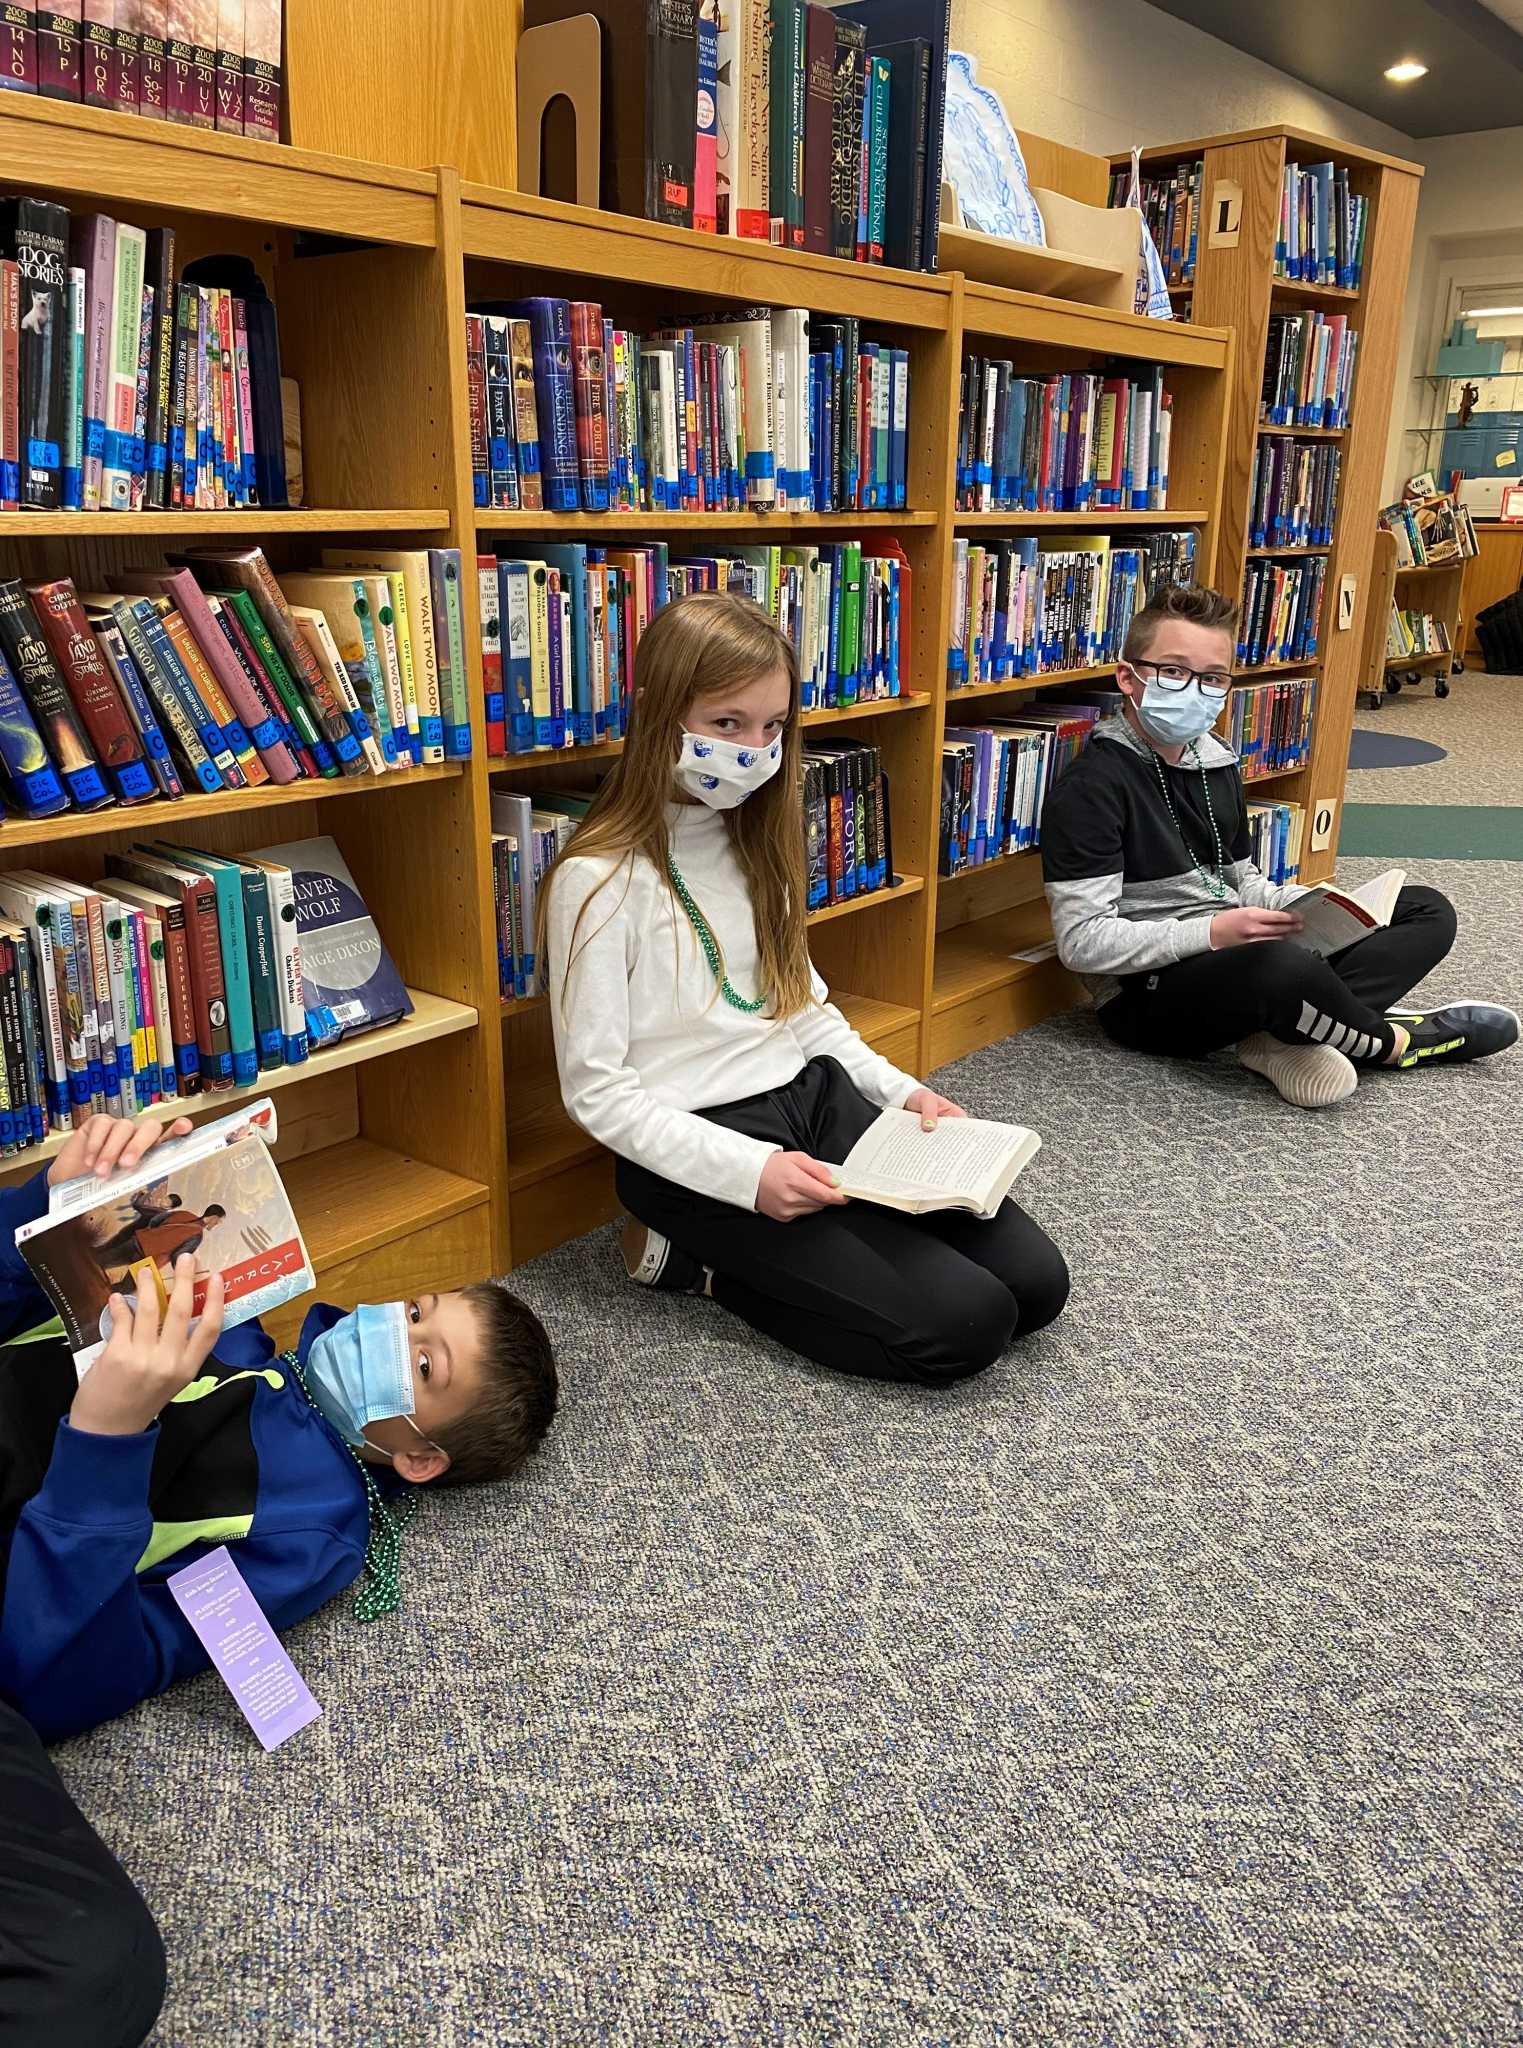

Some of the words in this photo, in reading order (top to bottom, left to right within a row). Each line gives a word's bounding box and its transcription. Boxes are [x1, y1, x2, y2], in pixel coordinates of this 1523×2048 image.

[5, 5, 27, 19] 2005
[53, 16, 74, 30] 2005
[10, 28, 24, 44] 14
[91, 24, 110, 38] 2005
[118, 32, 137, 46] 2005
[144, 36, 163, 50] 2005
[751, 1, 762, 62] Fishing
[790, 8, 800, 68] Illustrated
[12, 47, 24, 63] N
[57, 37, 71, 53] 15
[94, 45, 108, 61] 16
[172, 41, 191, 55] 2005
[195, 48, 215, 61] 2005
[12, 62, 25, 77] O
[60, 57, 69, 71] P
[121, 53, 134, 67] 17
[148, 57, 161, 73] 18
[176, 61, 189, 78] 19
[222, 52, 241, 65] 2005
[255, 61, 274, 74] 2005
[94, 65, 107, 81] Q
[121, 72, 133, 85] S-
[144, 75, 163, 92] So-
[197, 68, 212, 84] 20
[224, 72, 237, 87] 21
[96, 79, 105, 94] R
[120, 85, 134, 101] Sn
[147, 89, 161, 105] Sz
[177, 80, 186, 95] T
[199, 86, 209, 101] U
[218, 87, 233, 103] W
[236, 93, 243, 107] X
[257, 81, 270, 96] 22
[199, 99, 209, 113] V
[221, 100, 230, 115] Y
[232, 105, 241, 119] Z
[249, 95, 278, 112] Research
[791, 69, 800, 131] Children's
[750, 73, 761, 178] Encyclopedia
[761, 100, 771, 135] New
[831, 76, 842, 209] DICTIONARY
[790, 134, 799, 195] Dictionary
[872, 169, 881, 243] DICTIONAR
[1216, 199, 1239, 233] L
[18, 245, 61, 270] DOG
[16, 258, 64, 286] STORIES
[10, 302, 18, 332] STORY
[178, 351, 187, 373] BEAST
[159, 380, 167, 408] DOWN
[177, 380, 186, 424] BASKERVILLE
[469, 384, 480, 414] FIRE
[495, 390, 504, 423] DARK
[592, 384, 602, 409] FIRE
[555, 381, 568, 455] ASCENDING
[470, 417, 481, 453] STAR
[593, 414, 603, 456] WORLD
[48, 592, 72, 604] CHRIS
[48, 599, 77, 613] COLFER
[398, 582, 406, 614] CREECH
[1341, 591, 1354, 617] N
[420, 595, 431, 635] WALK
[17, 640, 47, 671] LAND
[68, 638, 96, 667] LAND
[128, 626, 157, 674] GREGOR
[423, 638, 434, 669] TWO
[23, 663, 56, 684] STORIES
[73, 661, 105, 681] STORIES
[260, 635, 274, 654] SPY
[269, 651, 285, 676] NEXT
[281, 675, 297, 699] DOOR
[390, 658, 399, 686] TWO
[163, 649, 181, 678] GREGOR
[183, 685, 205, 721] PROPHECY
[200, 671, 215, 694] CURSE
[426, 673, 438, 716] MOON
[857, 793, 866, 864] CAUGH
[1316, 809, 1331, 834] O
[844, 801, 855, 875] TORN
[295, 877, 339, 902] LVER
[295, 896, 342, 923] WOLF
[256, 915, 265, 937] David
[258, 937, 270, 977] Copperfield
[285, 955, 294, 979] Charles
[293, 946, 303, 979] OLIVER
[301, 951, 336, 972] AIGE
[338, 937, 381, 961] DIXON
[176, 946, 192, 1040] DESPEREAUX
[287, 979, 296, 1004] Dickens
[295, 979, 305, 1007] TWIST
[50, 997, 61, 1035] FAIRMOUNT
[55, 1037, 64, 1062] AVENUE
[193, 1252, 296, 1303] LAURENE
